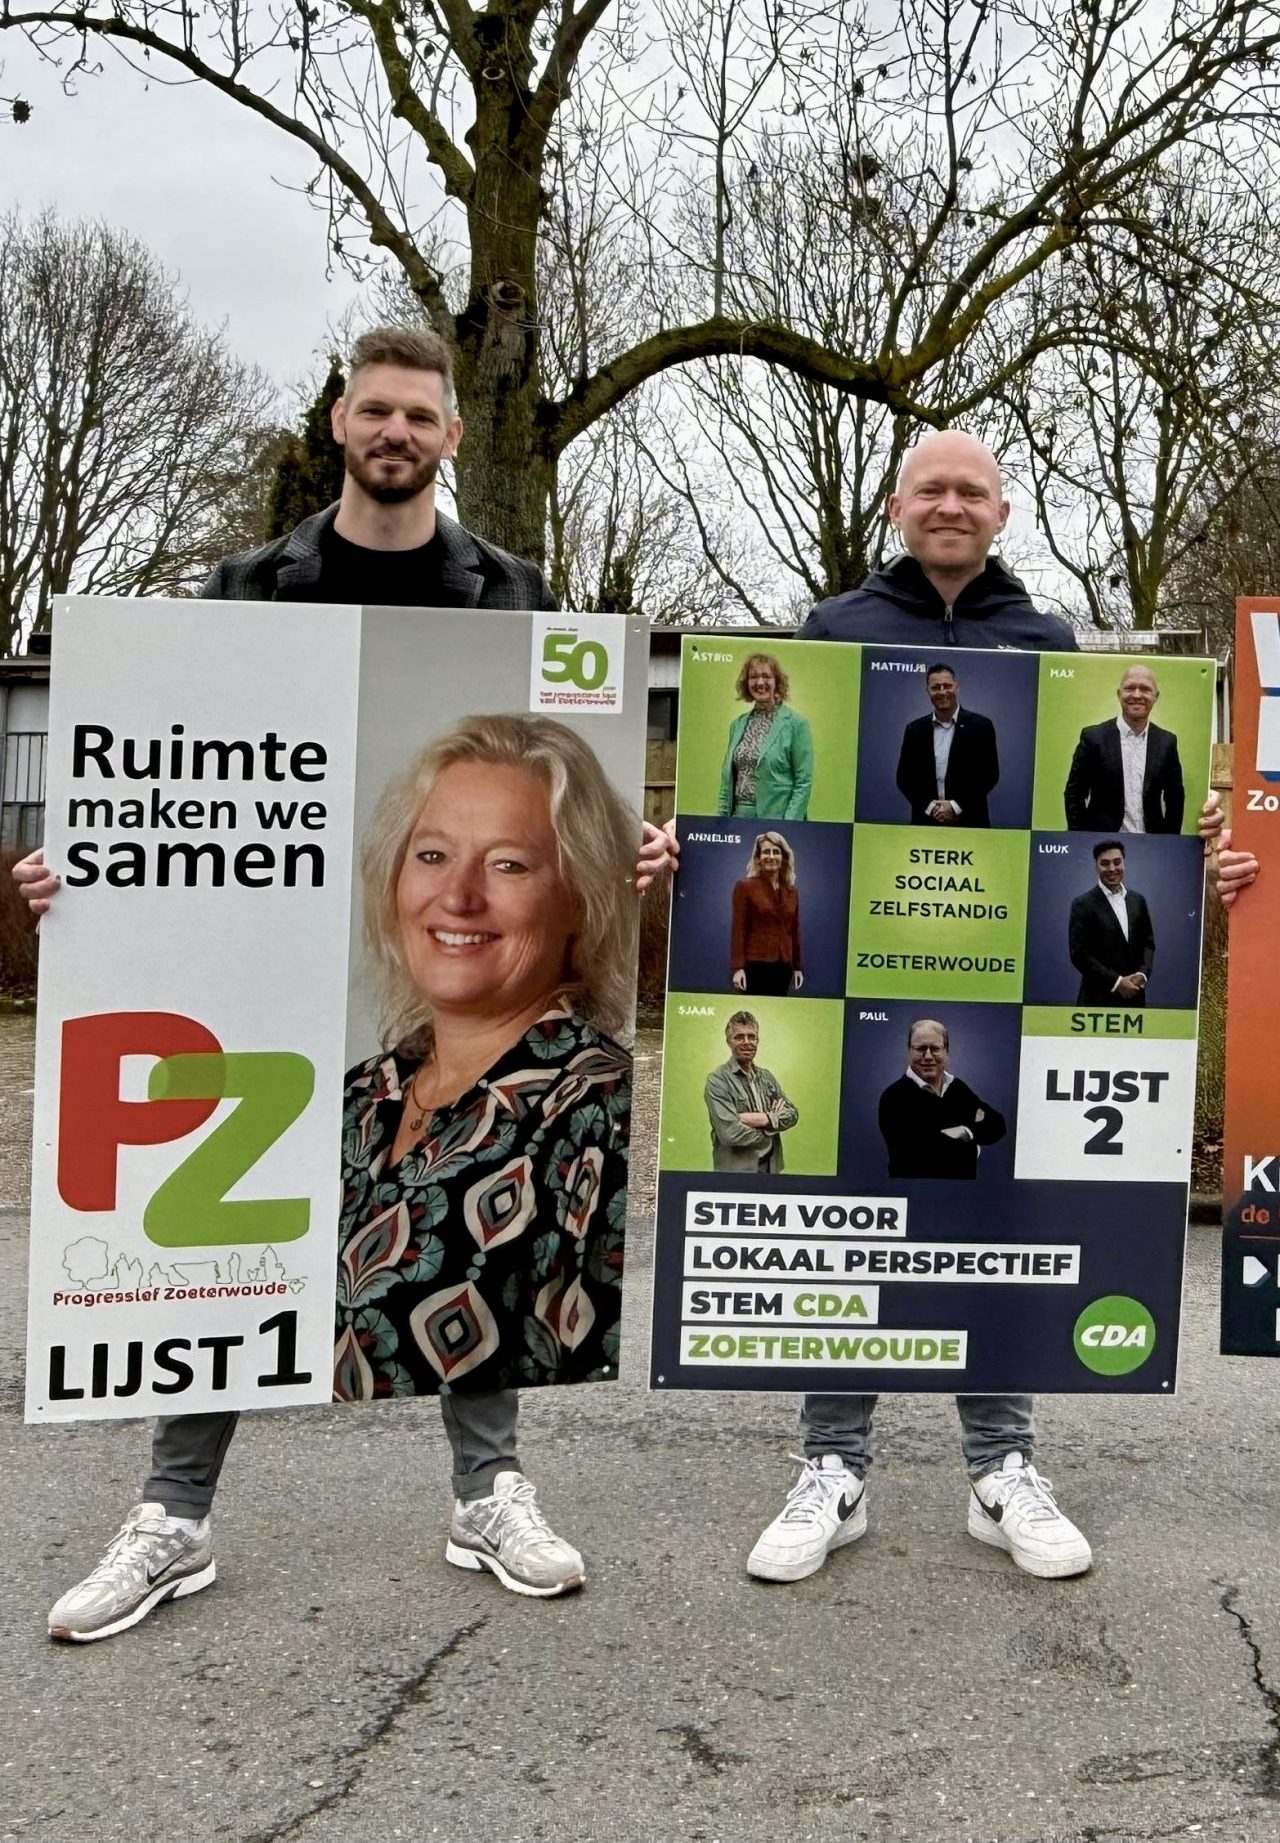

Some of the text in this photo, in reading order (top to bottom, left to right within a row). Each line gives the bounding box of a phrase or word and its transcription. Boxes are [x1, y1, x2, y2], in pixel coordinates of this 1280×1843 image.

[541, 633, 609, 691] 50
[692, 652, 733, 662] ASTRID
[1049, 668, 1075, 678] MAX
[72, 724, 328, 783] Ruimte
[67, 788, 328, 831] maken we
[687, 832, 741, 844] ANNELIES
[1039, 844, 1069, 854] LUUK
[65, 840, 326, 889] samen
[908, 848, 974, 867] STERK
[894, 874, 985, 893] SOCIAAL
[869, 900, 1009, 920] ZELFSTANDIG
[856, 953, 1016, 974] ZOETERWOUDE
[678, 1005, 716, 1016] SJAAK
[859, 1011, 888, 1022] PAUL
[1070, 1012, 1143, 1034] STEM
[1045, 1069, 1169, 1103] LIJST
[57, 1012, 315, 1247] PZ
[1083, 1105, 1123, 1155] 2
[694, 1201, 899, 1230] STEM VOOR
[1241, 1204, 1270, 1224] de
[692, 1246, 1073, 1276] LOKAAL PERSPECTIEF
[53, 1282, 288, 1307] Progressief Zoeterwoude
[689, 1291, 868, 1318] STEM CDA
[688, 1334, 960, 1362] ZOETERWOUDE
[1080, 1324, 1147, 1348] CDA
[49, 1310, 313, 1401] LIJST 1
